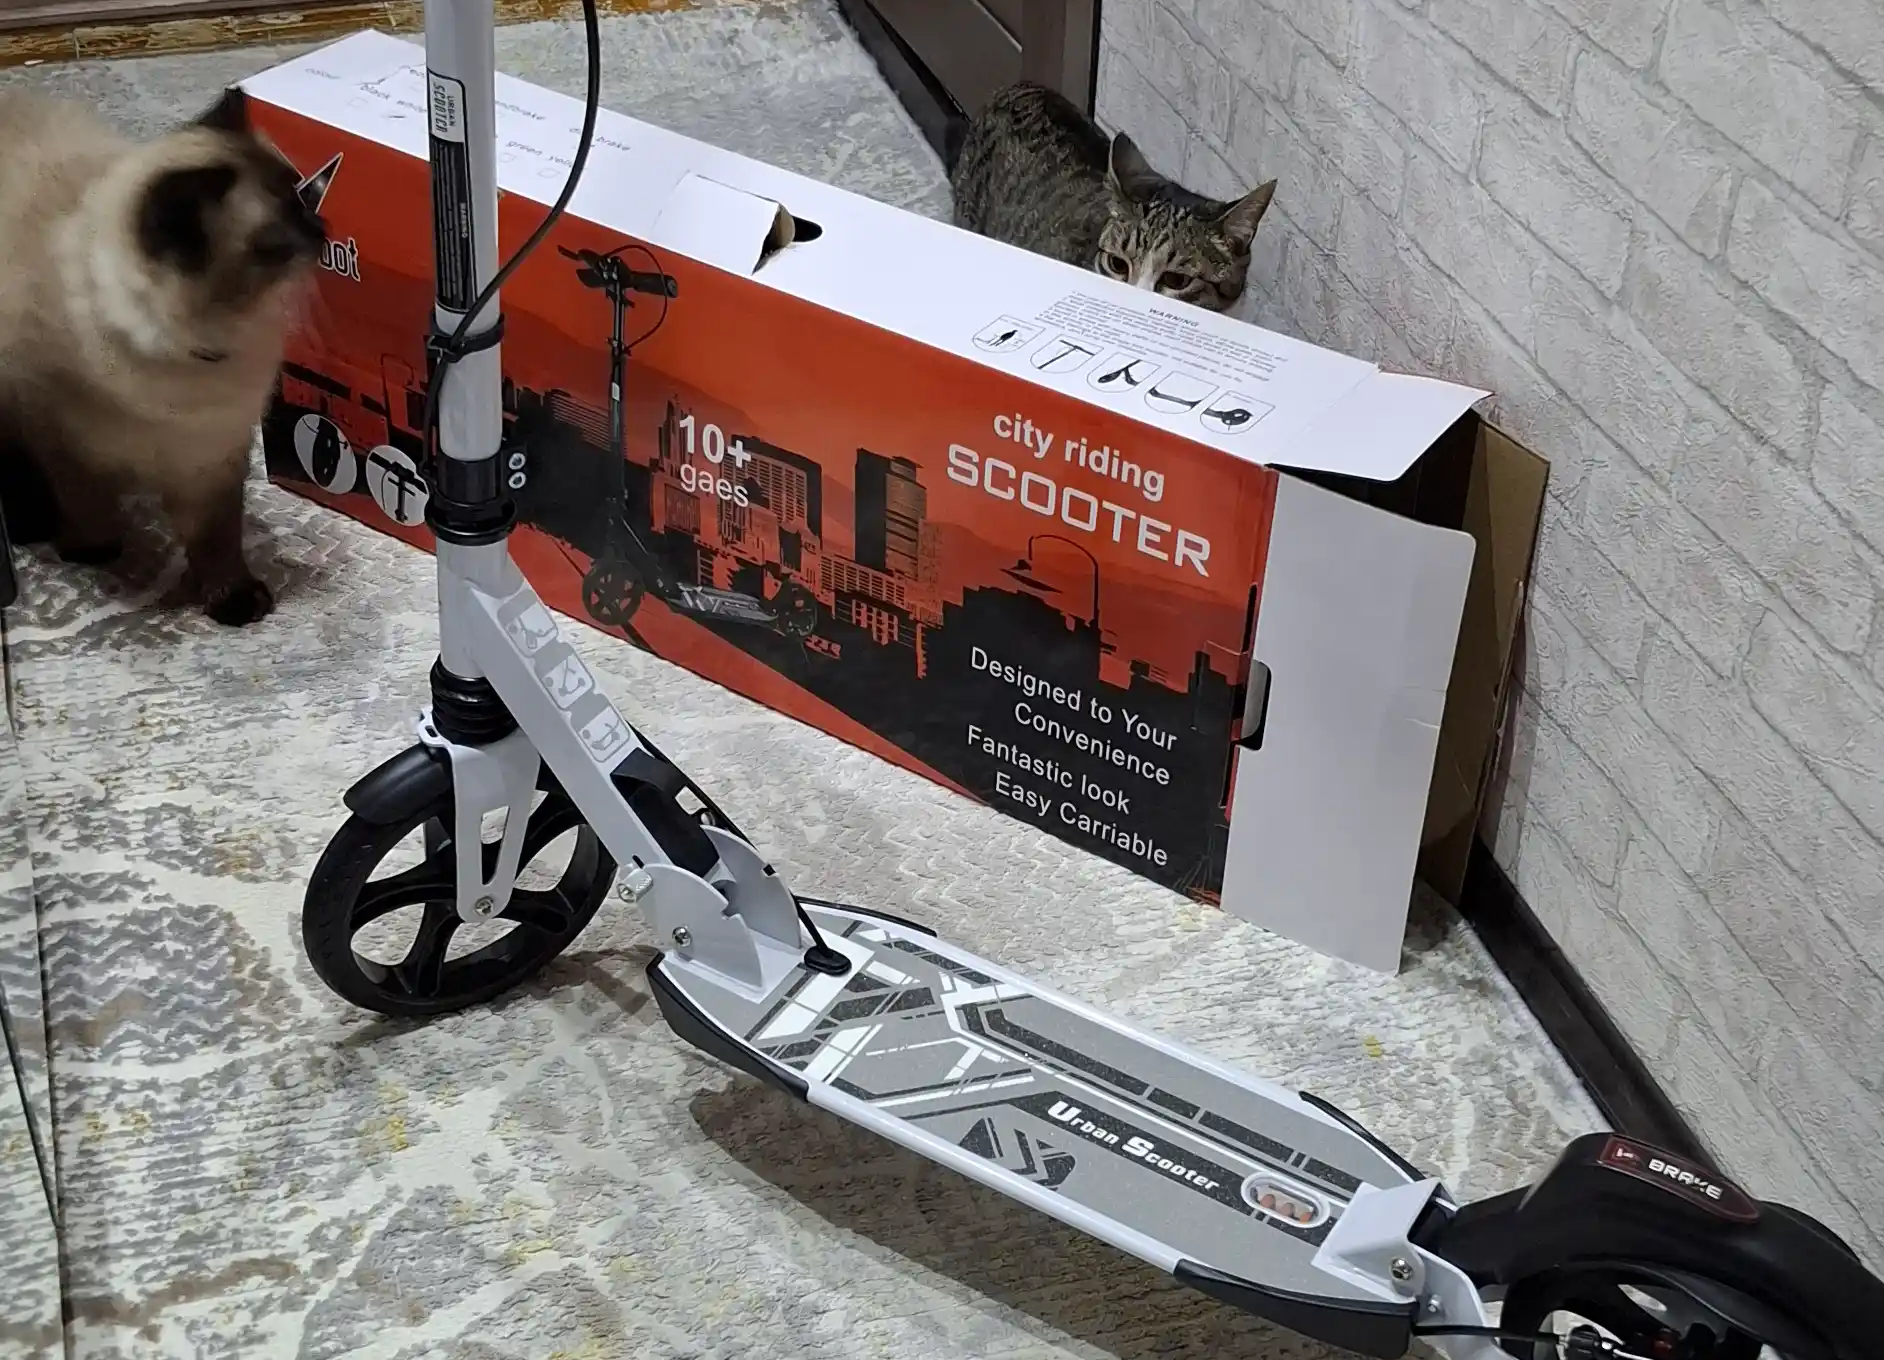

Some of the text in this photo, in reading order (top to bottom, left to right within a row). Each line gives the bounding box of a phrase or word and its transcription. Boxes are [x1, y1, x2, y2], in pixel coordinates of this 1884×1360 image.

[447, 95, 457, 127] URBAN
[1149, 308, 1200, 328] WARNING
[679, 414, 752, 469] 10+
[993, 413, 1165, 502] city riding
[680, 463, 749, 508] gaes
[947, 443, 1211, 578] SCOOTER
[971, 646, 1178, 751] Designed to Your
[967, 724, 1130, 815] Fantastic look
[1014, 702, 1171, 785] Convenience
[995, 771, 1169, 866] Easy Carriable
[1047, 1100, 1221, 1191] Urban Scooter
[1648, 1158, 1724, 1201] BRAKE
